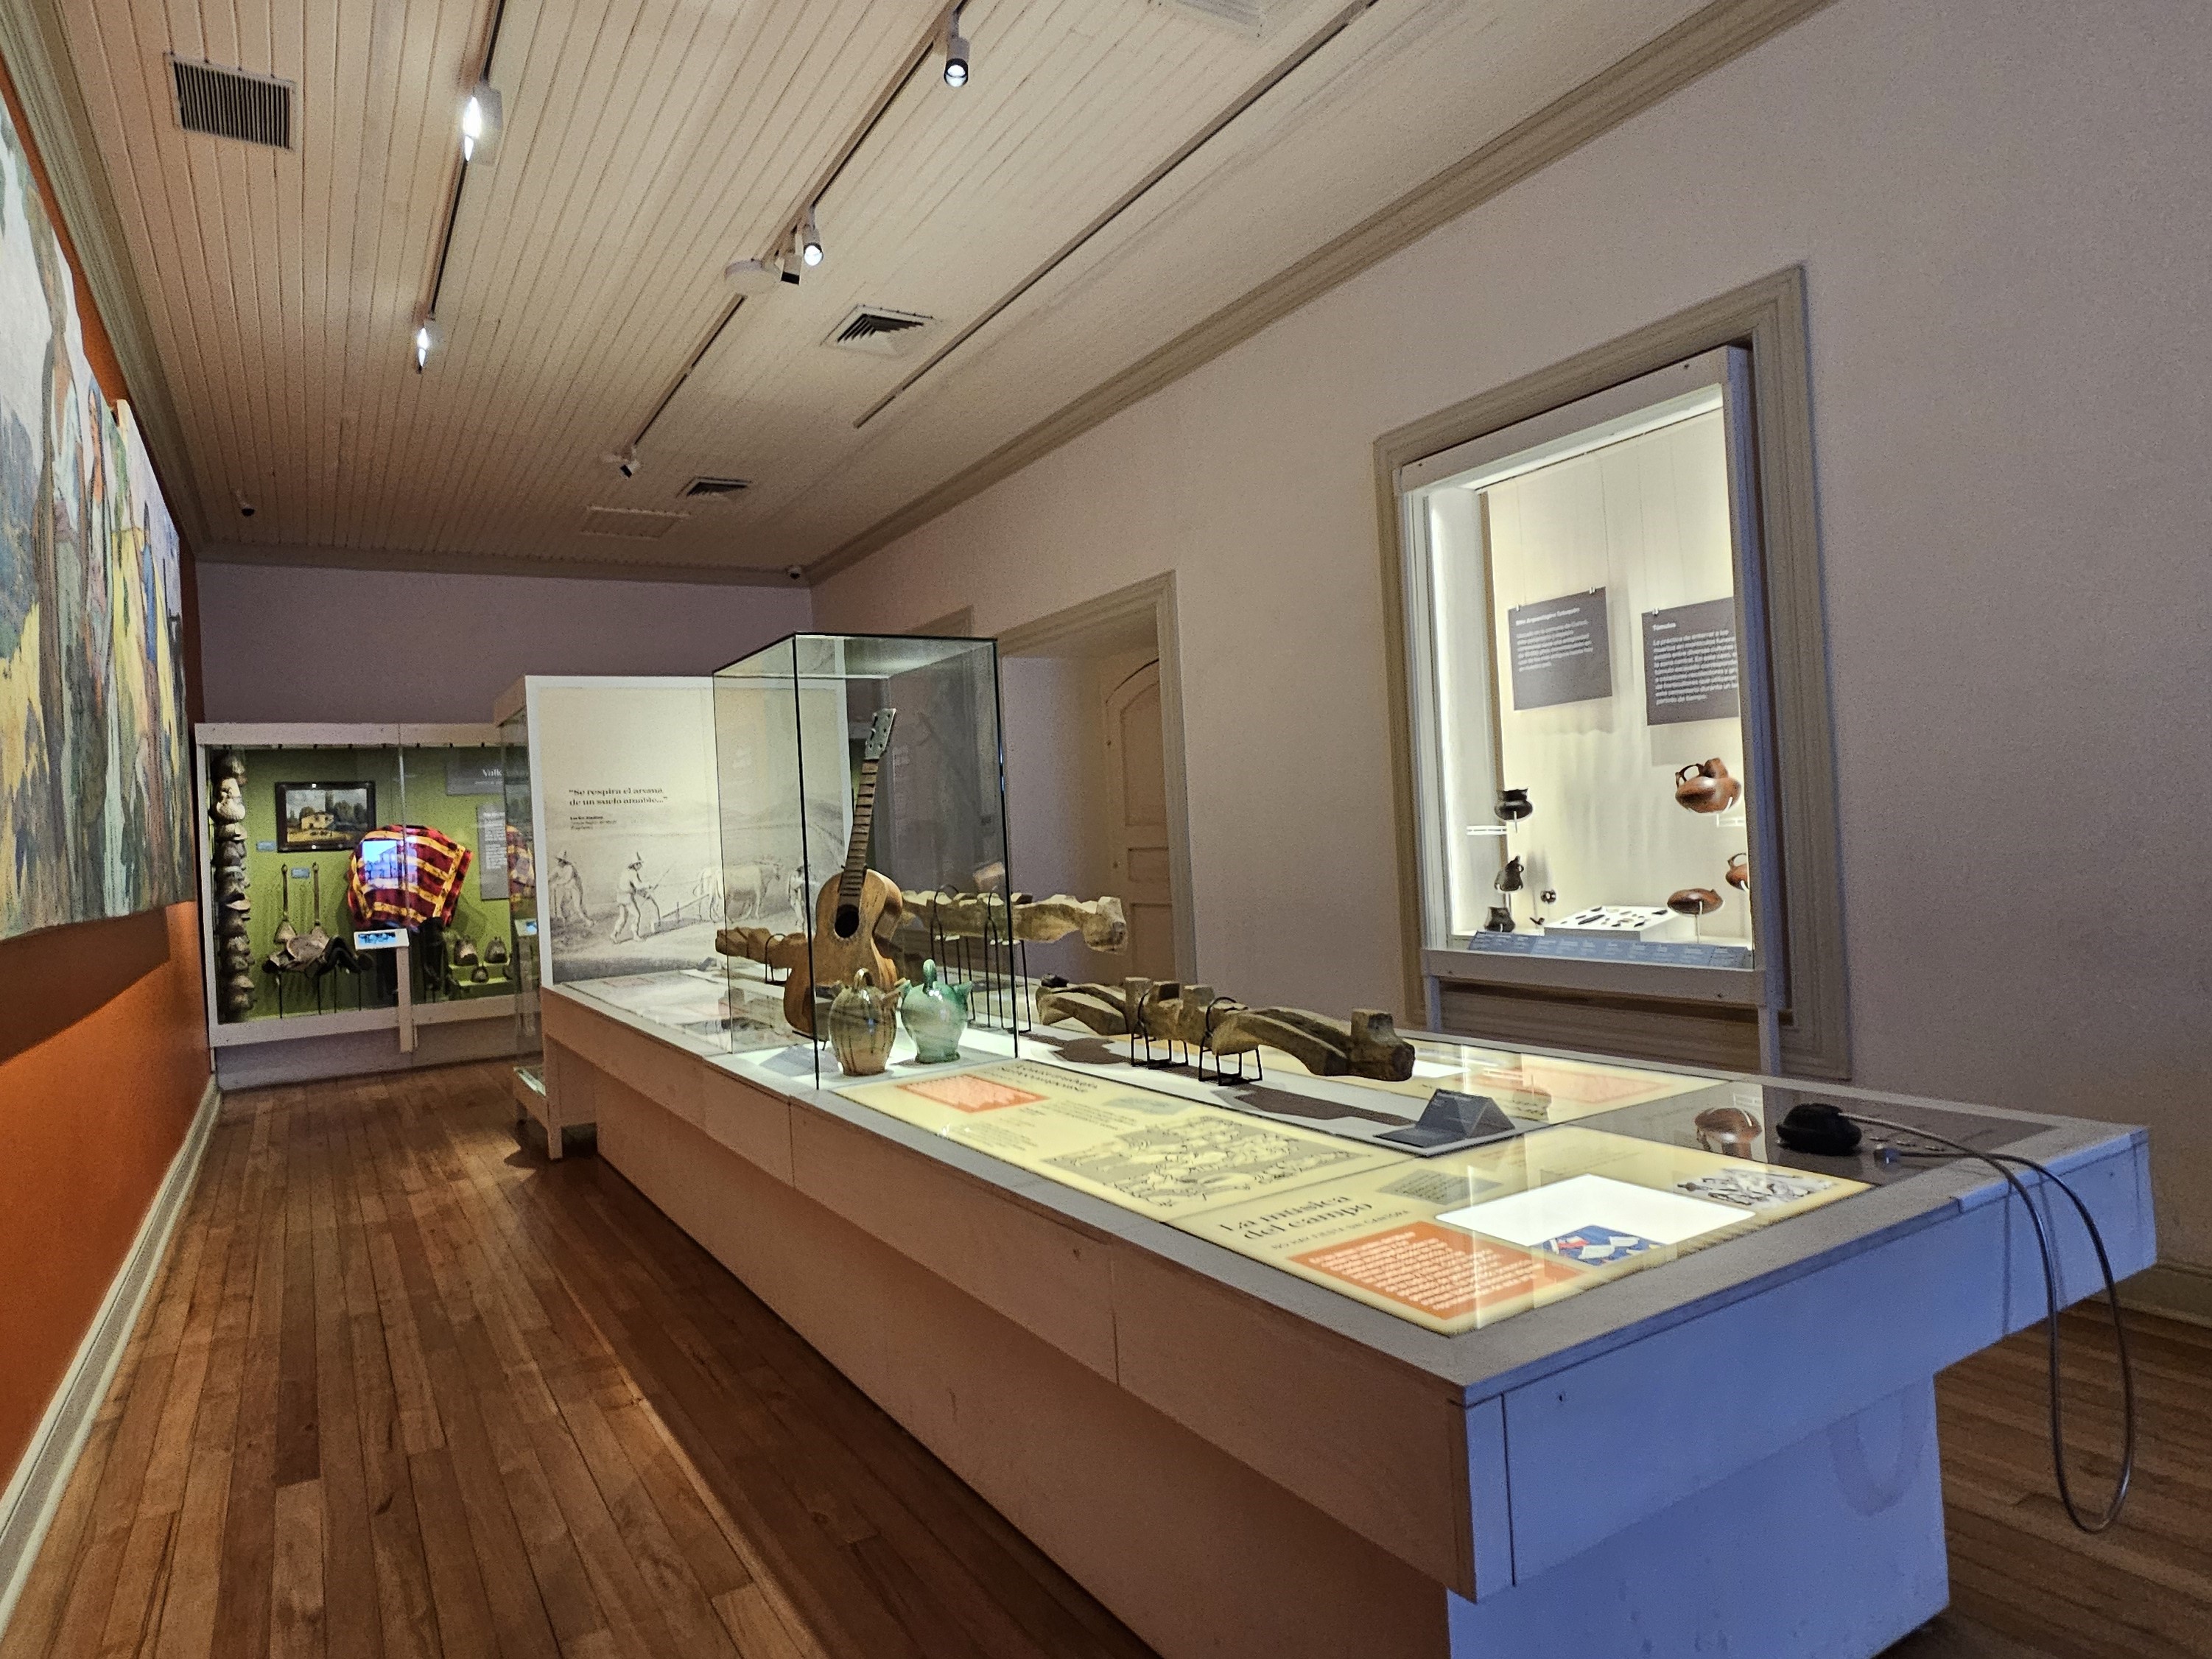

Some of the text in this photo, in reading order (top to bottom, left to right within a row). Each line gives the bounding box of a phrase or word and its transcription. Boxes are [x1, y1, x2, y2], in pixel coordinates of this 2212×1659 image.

[588, 788, 621, 796] respira
[1219, 1195, 1351, 1232] La música
[1243, 1202, 1373, 1240] del campo
